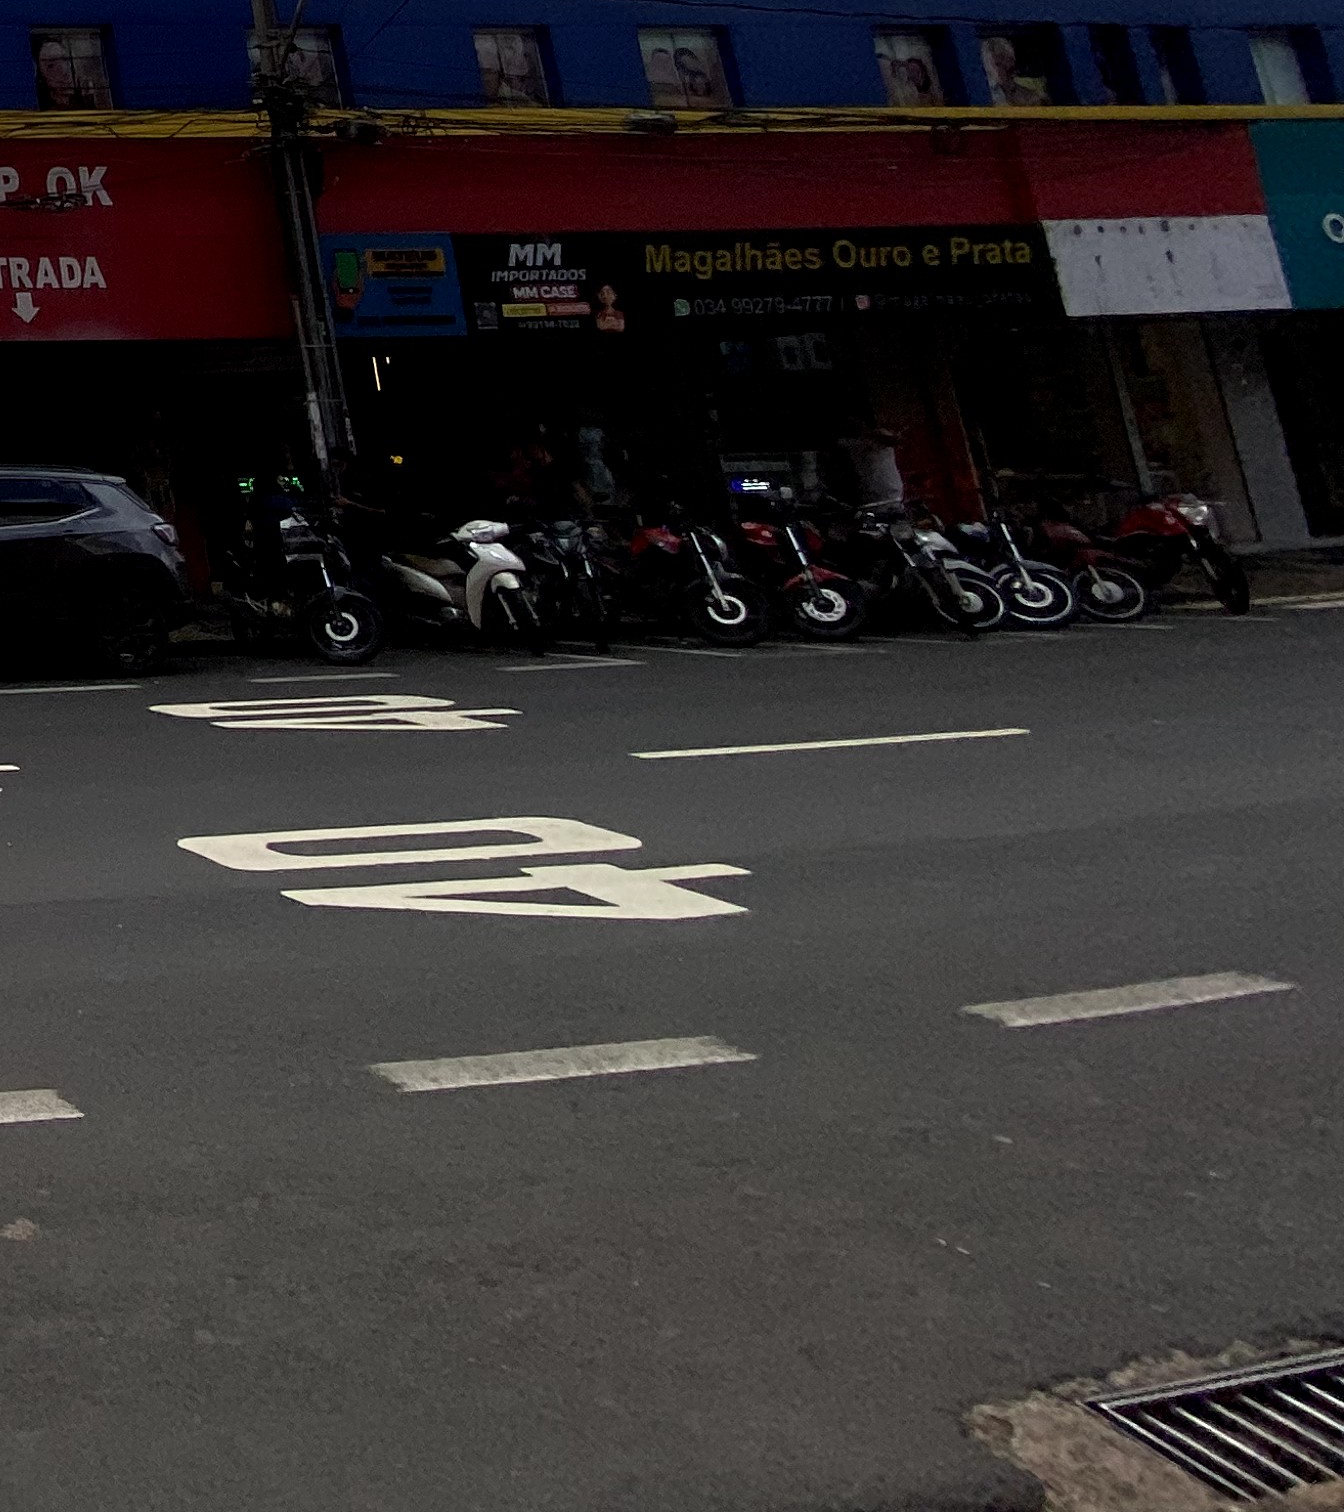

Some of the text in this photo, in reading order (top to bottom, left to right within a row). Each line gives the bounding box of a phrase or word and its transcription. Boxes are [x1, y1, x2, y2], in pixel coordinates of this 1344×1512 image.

[46, 166, 113, 207] OK
[508, 242, 562, 266] MM
[645, 237, 1031, 279] Magalhães Ouro e Prata
[491, 268, 587, 282] IMPORTADOS
[177, 815, 753, 922] 40
